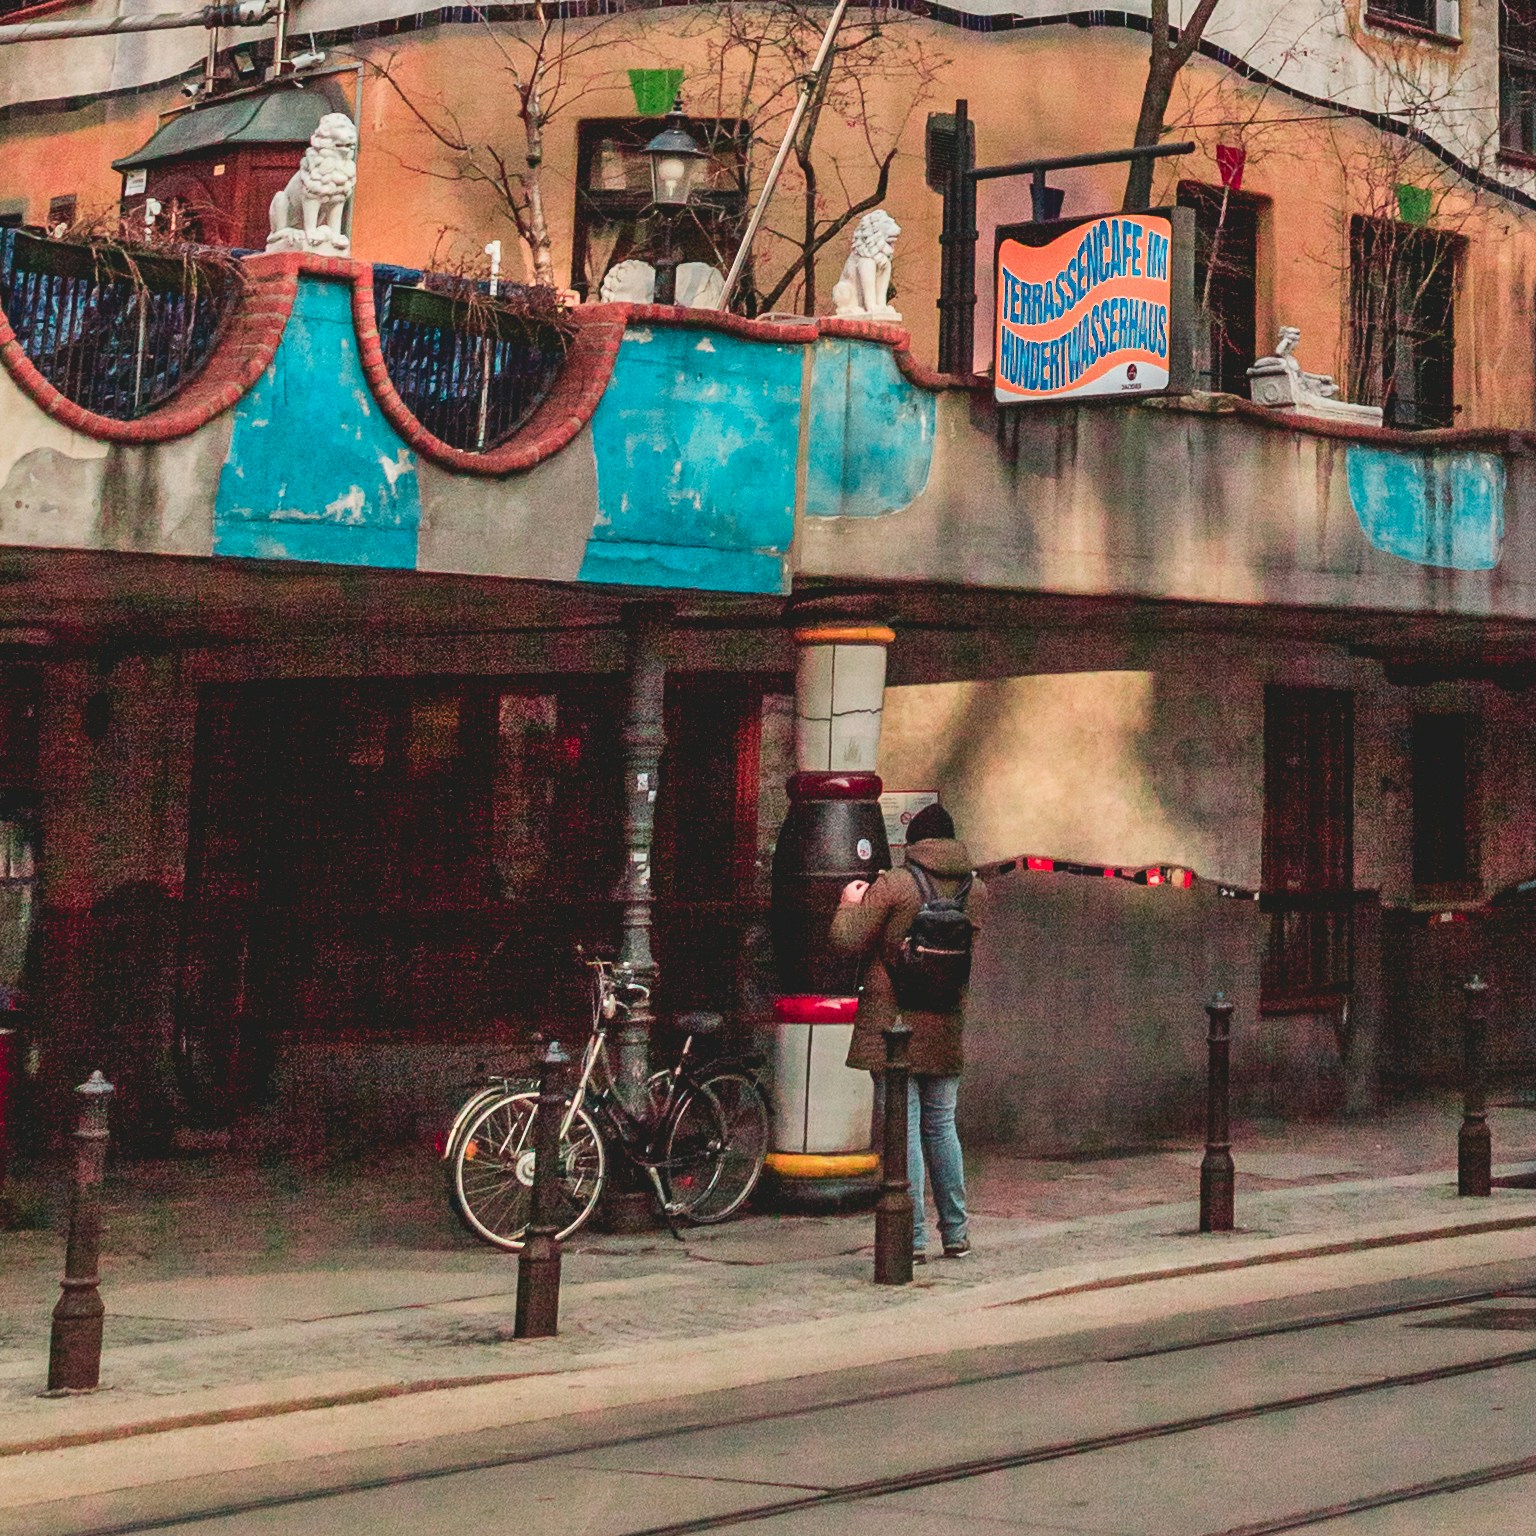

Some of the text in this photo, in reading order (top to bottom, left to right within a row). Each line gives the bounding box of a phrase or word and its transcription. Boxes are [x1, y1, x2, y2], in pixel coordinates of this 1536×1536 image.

[1002, 219, 1169, 326] TERRASSENCAFE IM
[1000, 297, 1168, 392] HUNDERTWASSERHAUS
